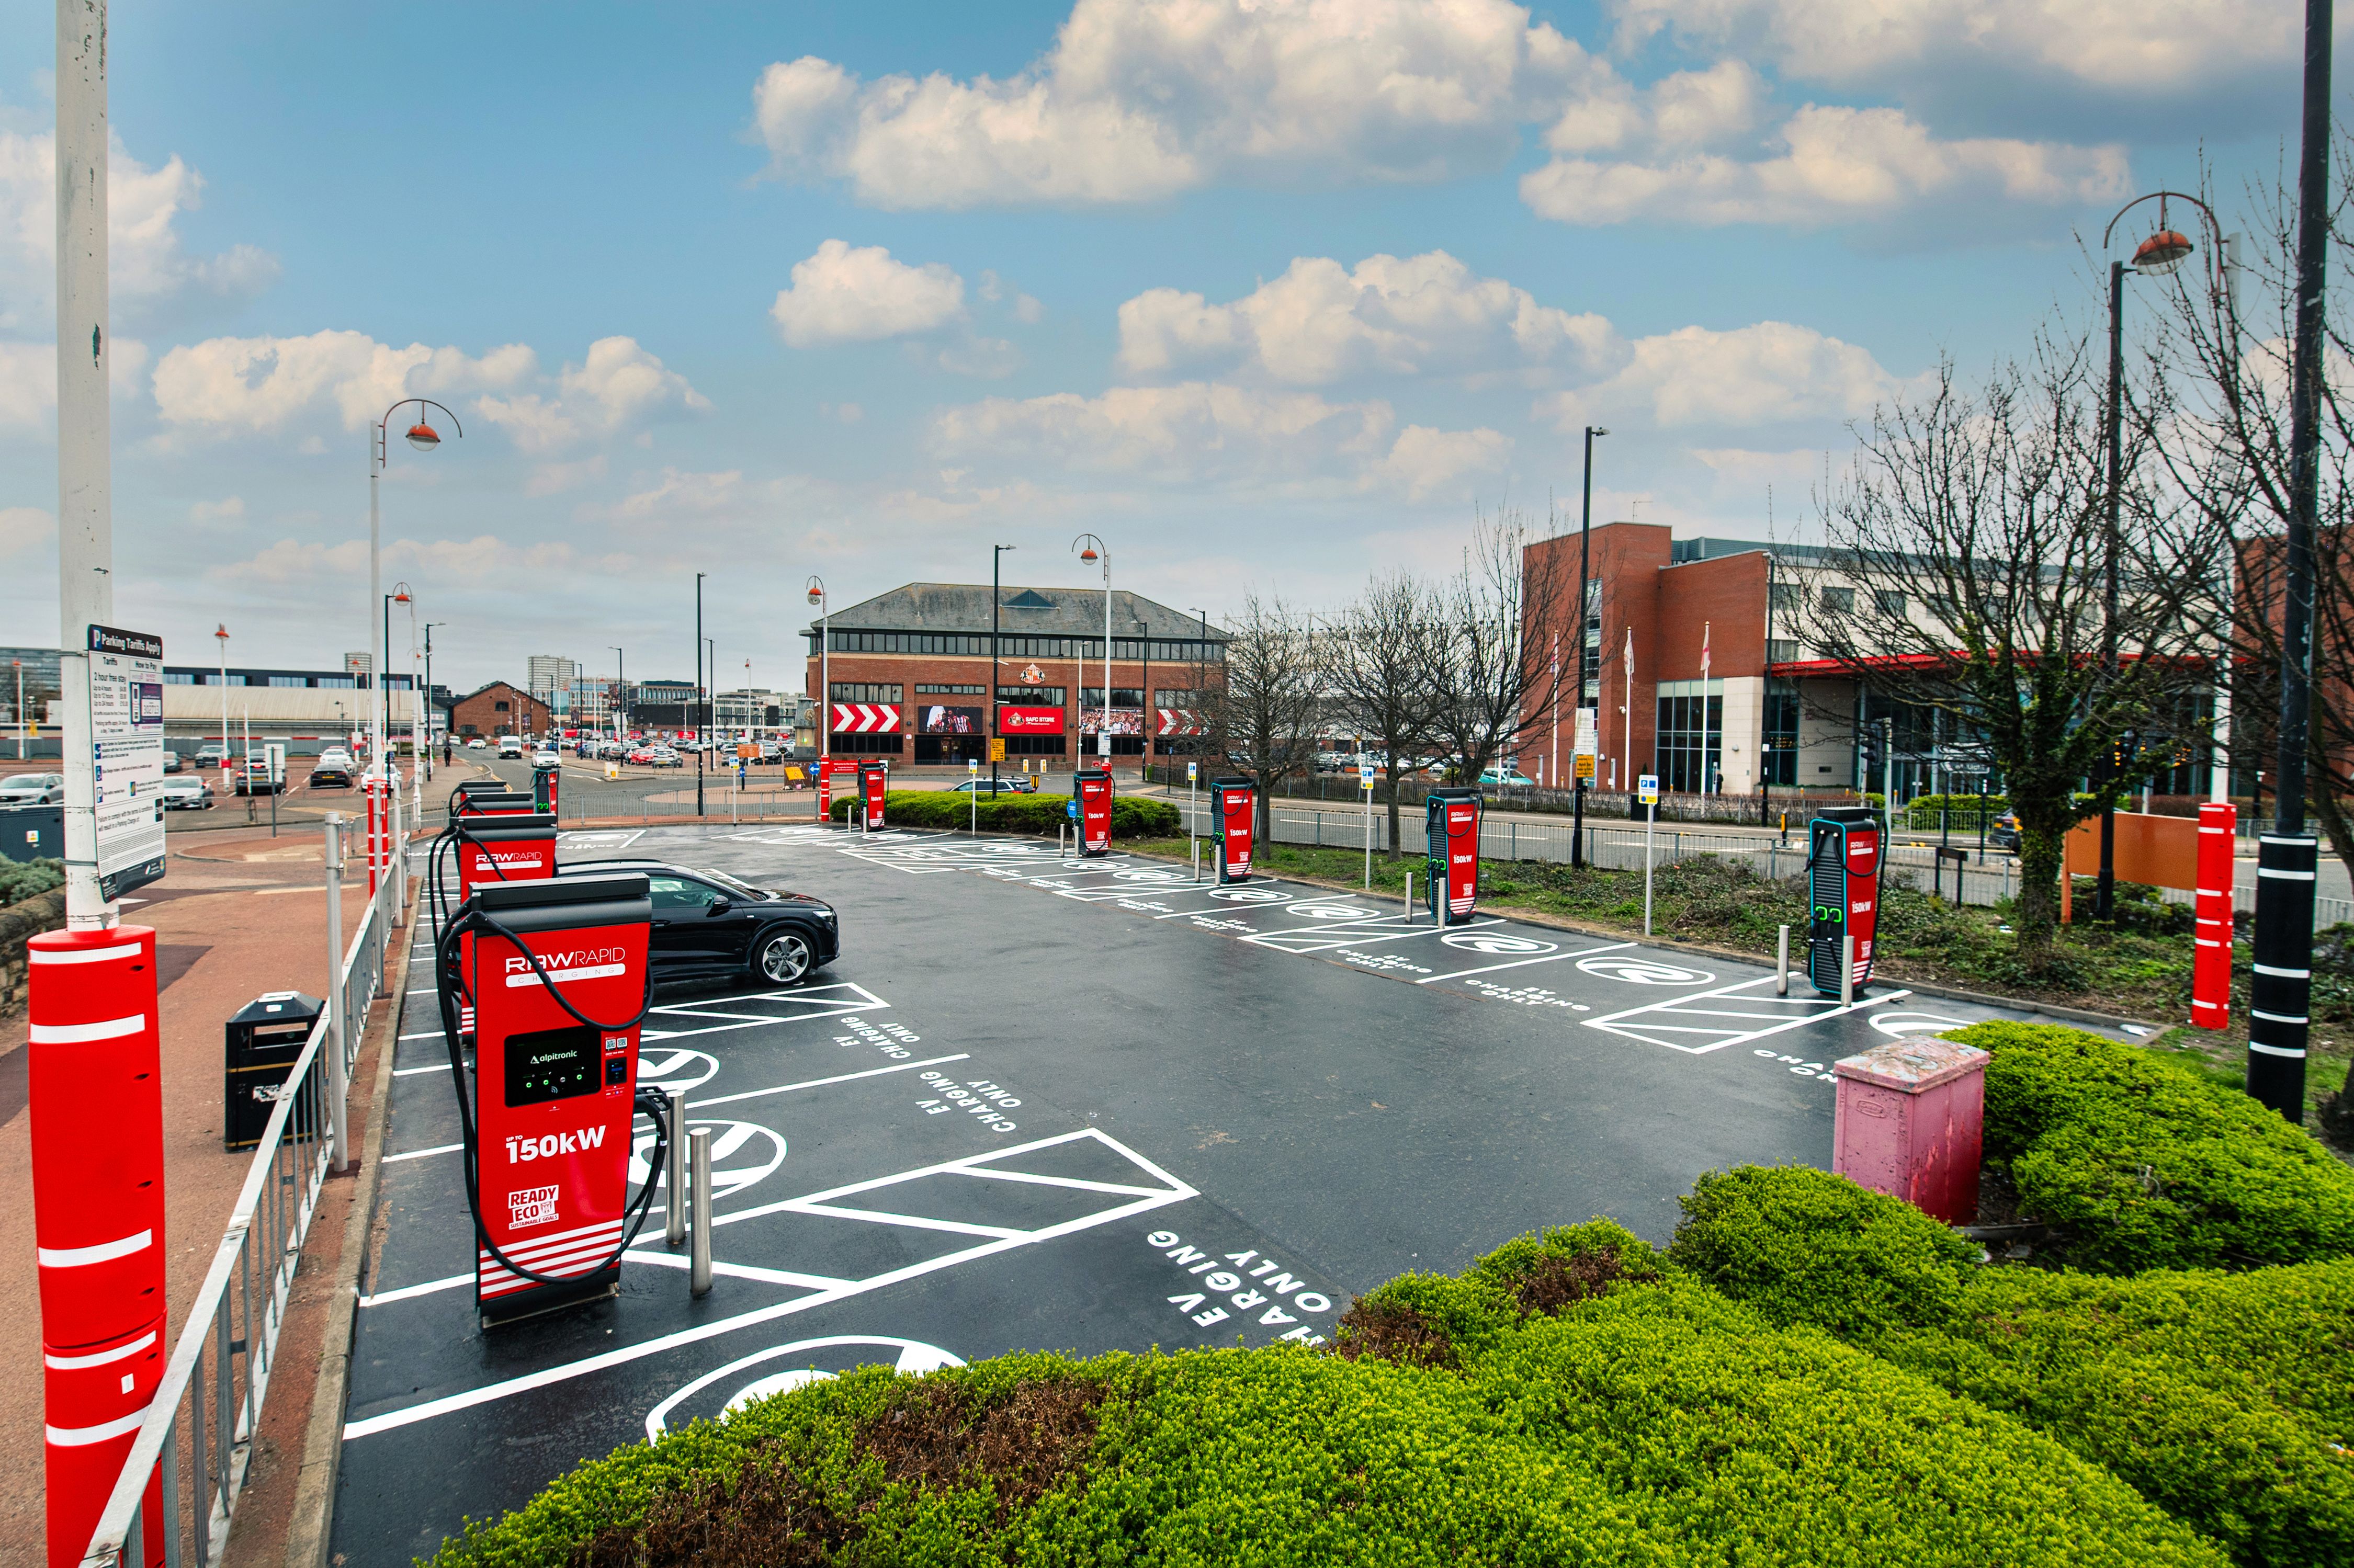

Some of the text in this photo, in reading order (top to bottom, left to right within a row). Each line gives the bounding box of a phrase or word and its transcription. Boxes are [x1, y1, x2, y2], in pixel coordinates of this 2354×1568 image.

[101, 633, 126, 651] Parking
[126, 638, 145, 651] Tariffs
[146, 641, 161, 655] Apply
[103, 656, 118, 666] Tariffs
[98, 673, 108, 681] hour
[109, 673, 117, 682] free
[1454, 855, 1472, 864] 150kW
[1852, 901, 1871, 914] 150kW
[518, 968, 615, 983] CHRGING
[1465, 980, 1590, 1010] CHARGING
[1481, 990, 1543, 1005] ONLY
[841, 1016, 911, 1059] CHARGING
[879, 1022, 920, 1042] ONLY
[832, 1036, 861, 1047] EV
[540, 1050, 578, 1062] alpitronic
[920, 1072, 1016, 1132] CHARGING
[967, 1080, 1021, 1108] ONLY
[915, 1099, 951, 1115] EV
[506, 1125, 606, 1164] 150kW
[511, 1187, 557, 1207] READY
[515, 1205, 539, 1222] ECO
[510, 1218, 541, 1229] SUSTAINABLE
[1147, 1231, 1325, 1347] HARGING
[1225, 1250, 1331, 1312] ONLY
[1168, 1293, 1230, 1327] EV
